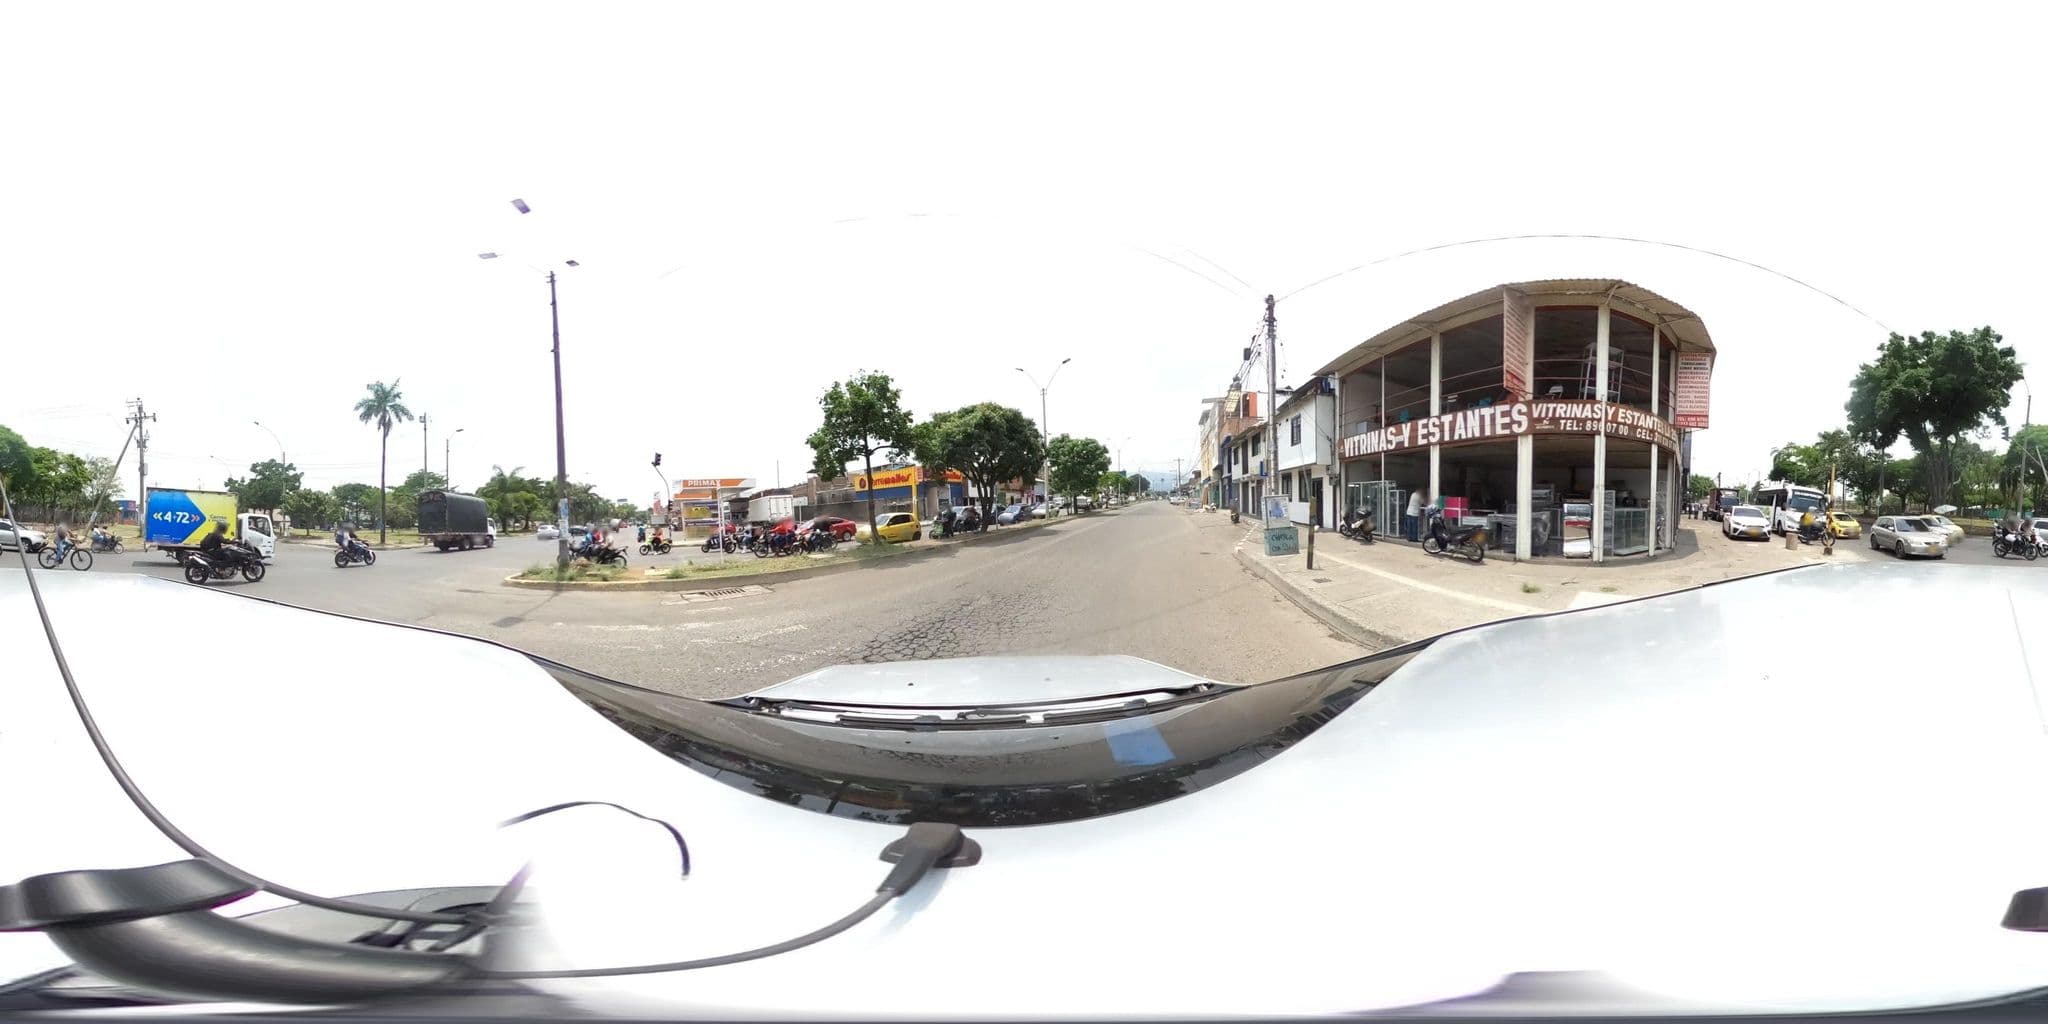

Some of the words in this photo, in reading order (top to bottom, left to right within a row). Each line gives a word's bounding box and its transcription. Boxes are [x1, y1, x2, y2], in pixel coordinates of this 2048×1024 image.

[1531, 403, 1602, 419] VITRINAS
[1606, 405, 1616, 420] Y
[1344, 426, 1396, 457] VITRINAS
[1402, 422, 1411, 447] Y
[1417, 404, 1528, 446] ESTANTES
[1560, 420, 1583, 431] TEL:
[1606, 422, 1617, 433] 07
[1618, 425, 1629, 436] 00
[1636, 428, 1653, 440] CEL:
